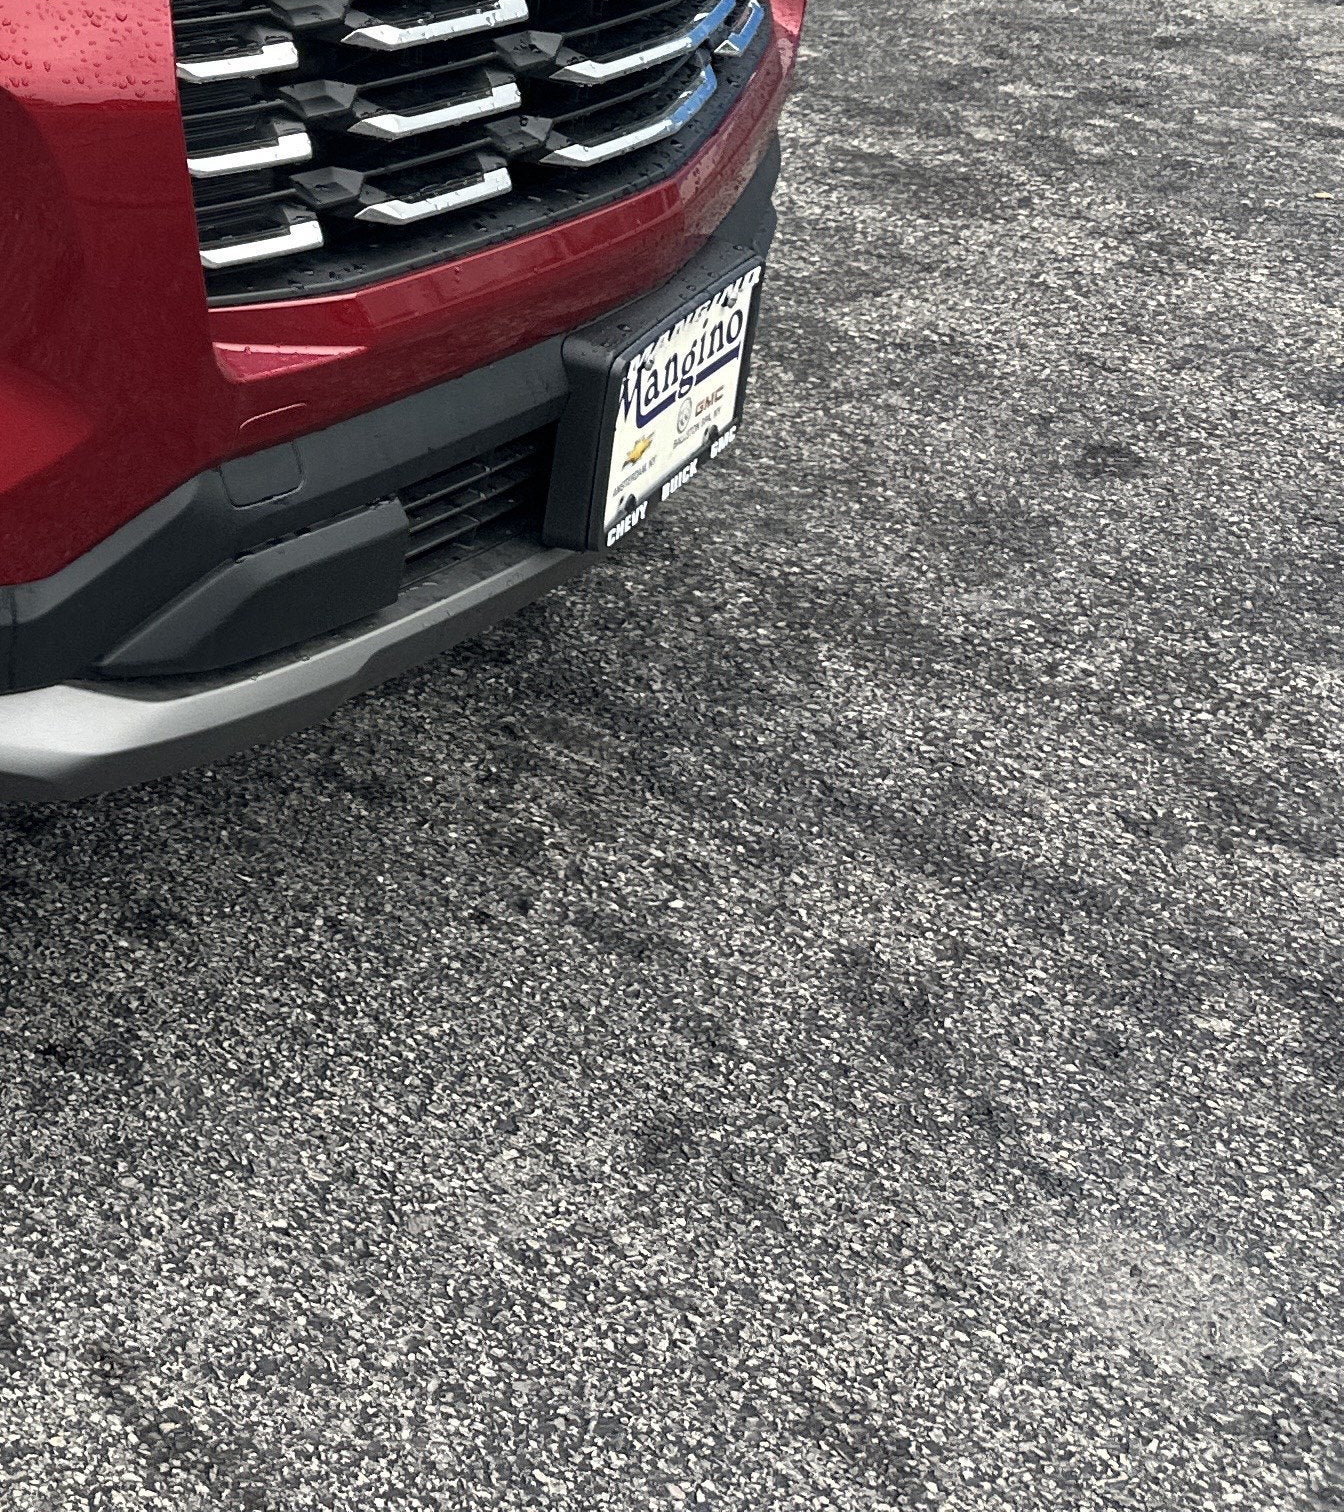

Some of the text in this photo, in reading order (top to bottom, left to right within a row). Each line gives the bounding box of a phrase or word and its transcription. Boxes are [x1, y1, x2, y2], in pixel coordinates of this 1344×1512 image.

[620, 308, 744, 428] Mangino
[695, 384, 725, 417] GMC
[606, 425, 738, 547] CHEVY BUICK GMC
